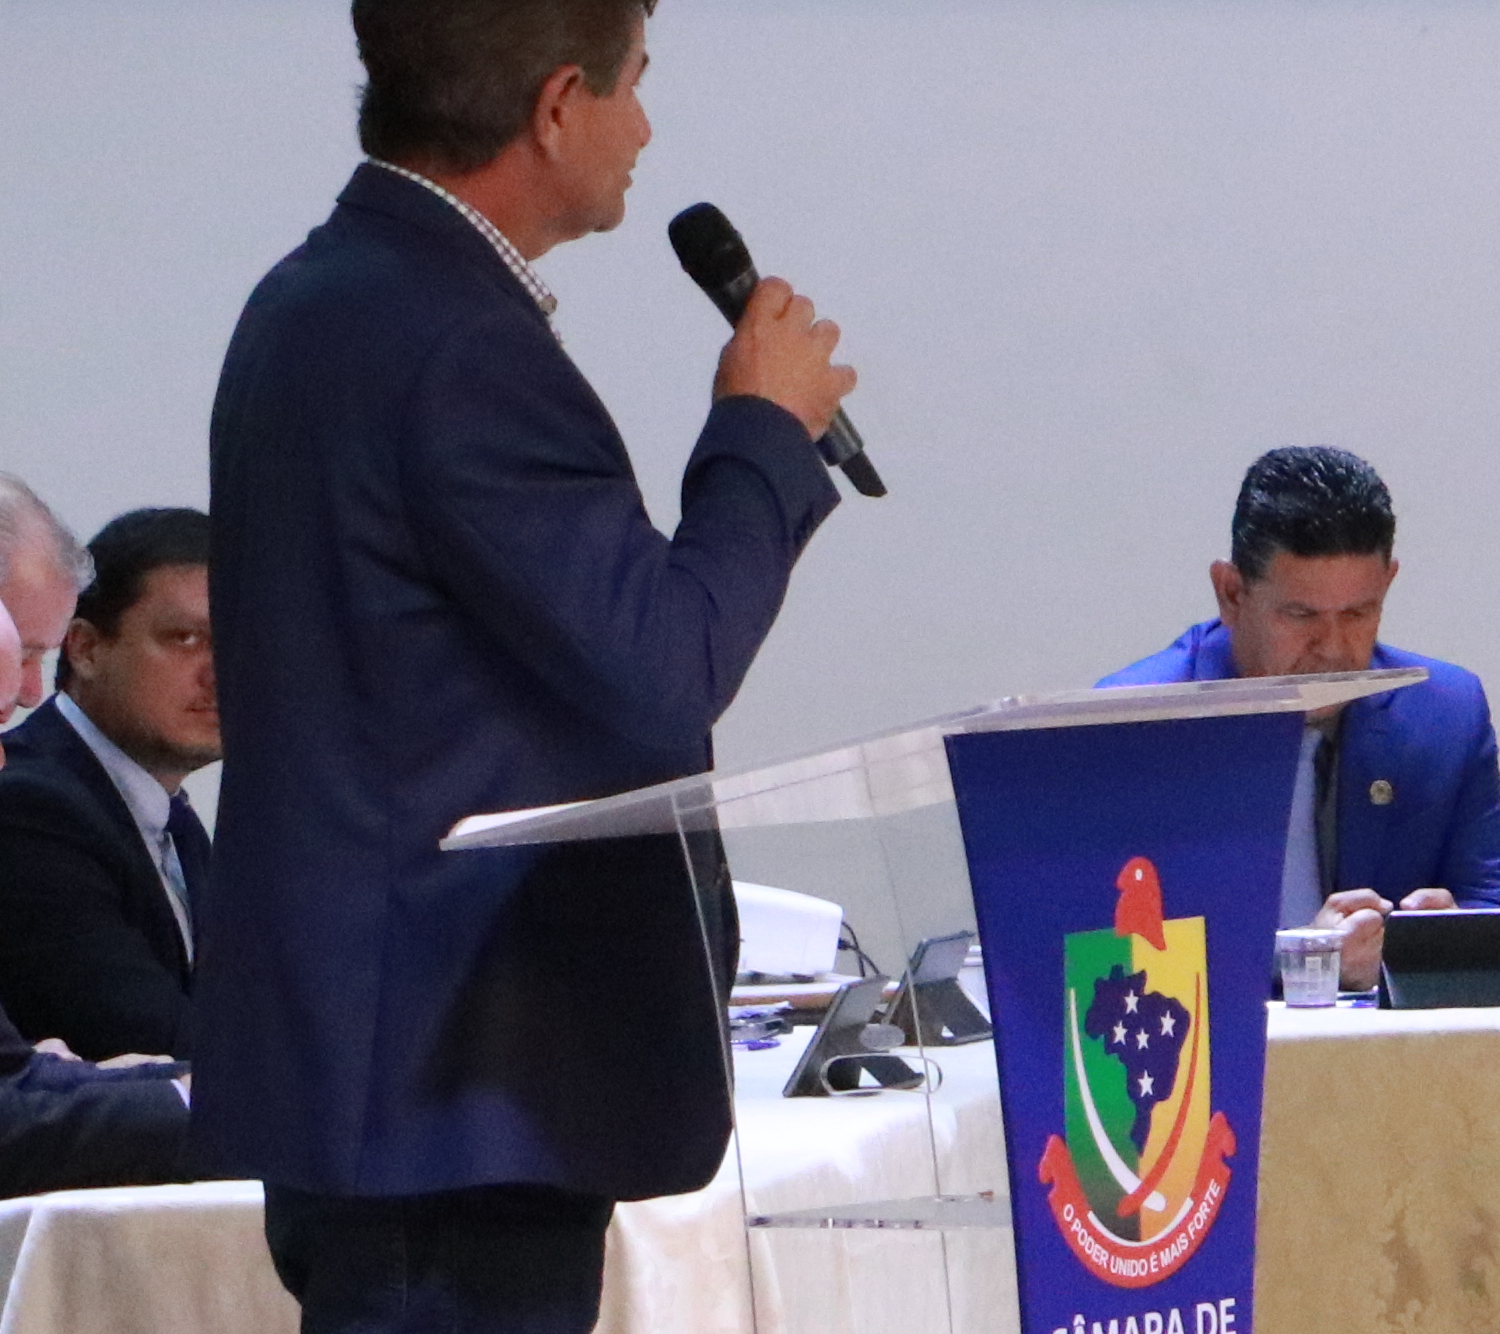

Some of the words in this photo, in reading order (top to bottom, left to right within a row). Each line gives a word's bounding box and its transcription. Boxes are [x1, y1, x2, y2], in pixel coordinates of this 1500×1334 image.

[1063, 1203, 1075, 1222] O
[1071, 1218, 1110, 1269] PODER
[1110, 1255, 1149, 1278] UNIDO
[1150, 1251, 1160, 1273] É
[1160, 1233, 1189, 1268] MAIS
[1187, 1178, 1221, 1240] FORTE
